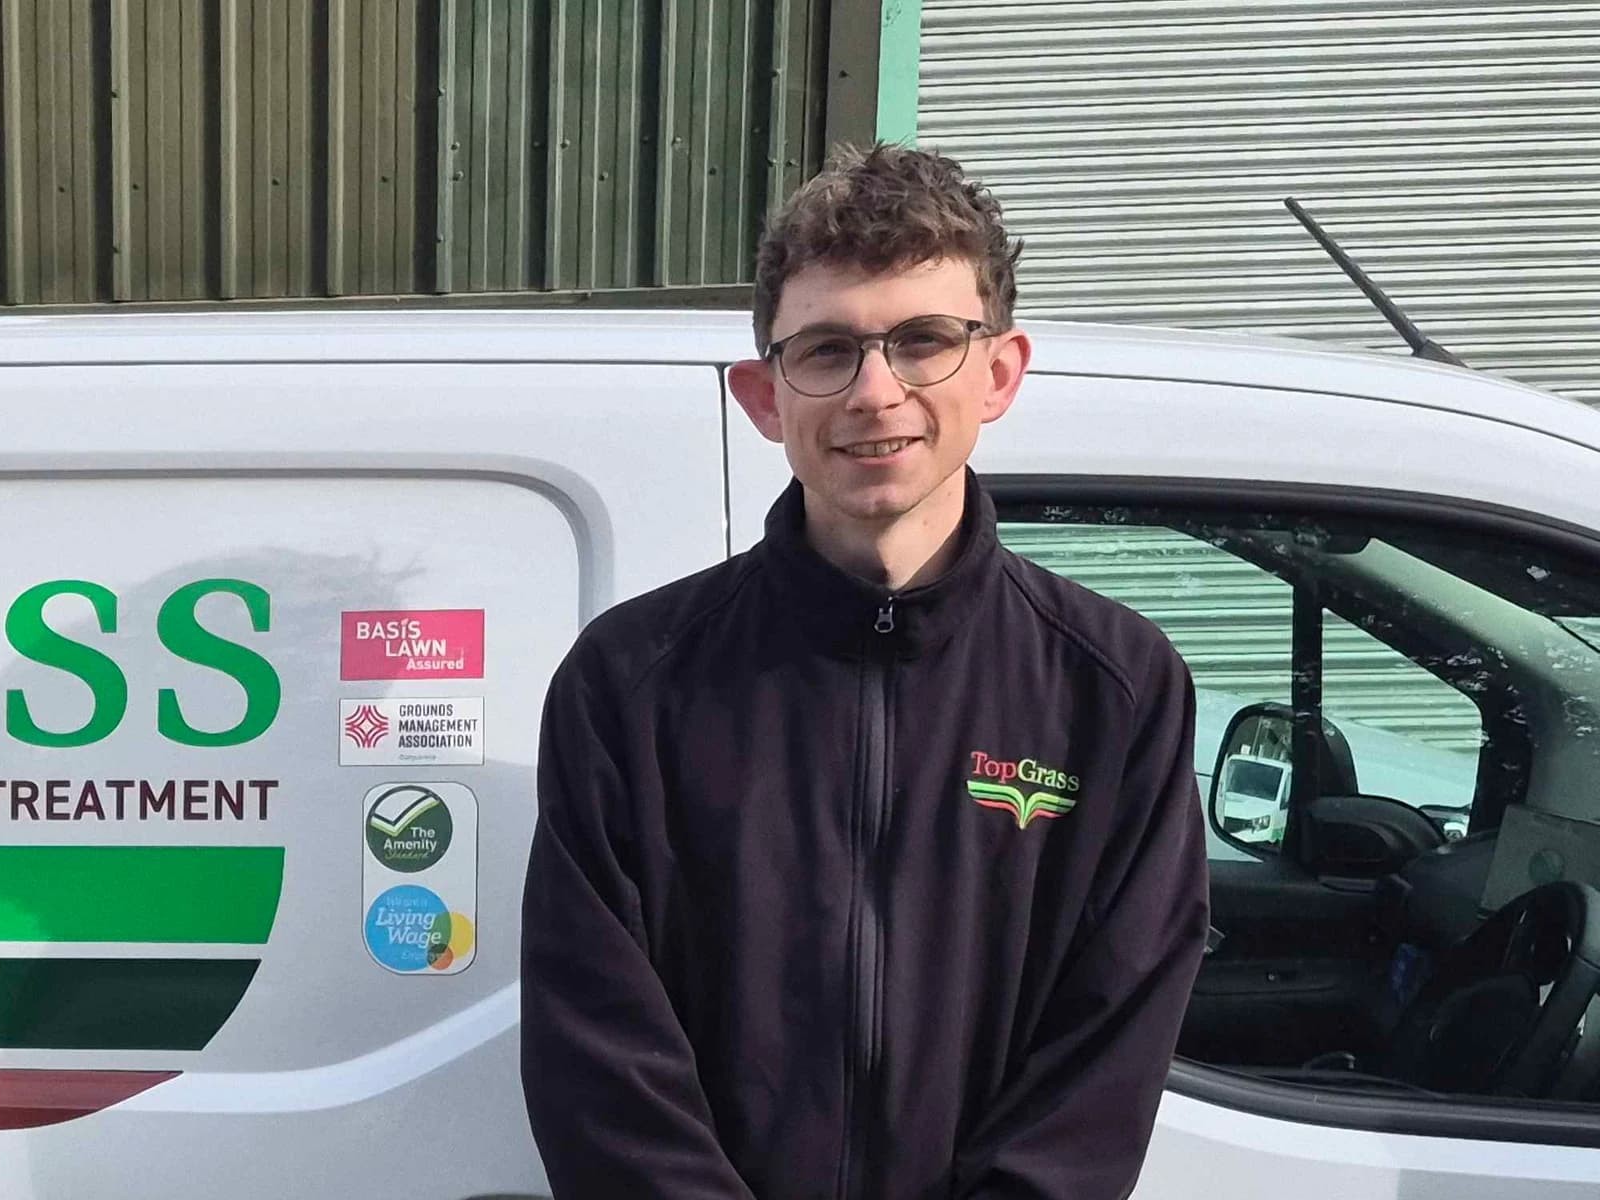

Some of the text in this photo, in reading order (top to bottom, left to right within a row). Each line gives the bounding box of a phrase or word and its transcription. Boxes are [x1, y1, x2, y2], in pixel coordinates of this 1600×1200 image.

[385, 639, 446, 657] LAWN
[406, 657, 464, 670] Assured
[399, 704, 453, 717] GROUNDS
[398, 719, 477, 733] MANAGEMENT
[398, 734, 472, 748] ASSOCIATION
[971, 751, 1080, 792] TopGrass
[412, 826, 436, 838] The
[384, 838, 437, 855] Amenity
[376, 908, 435, 929] Living
[388, 927, 442, 948] Wage
